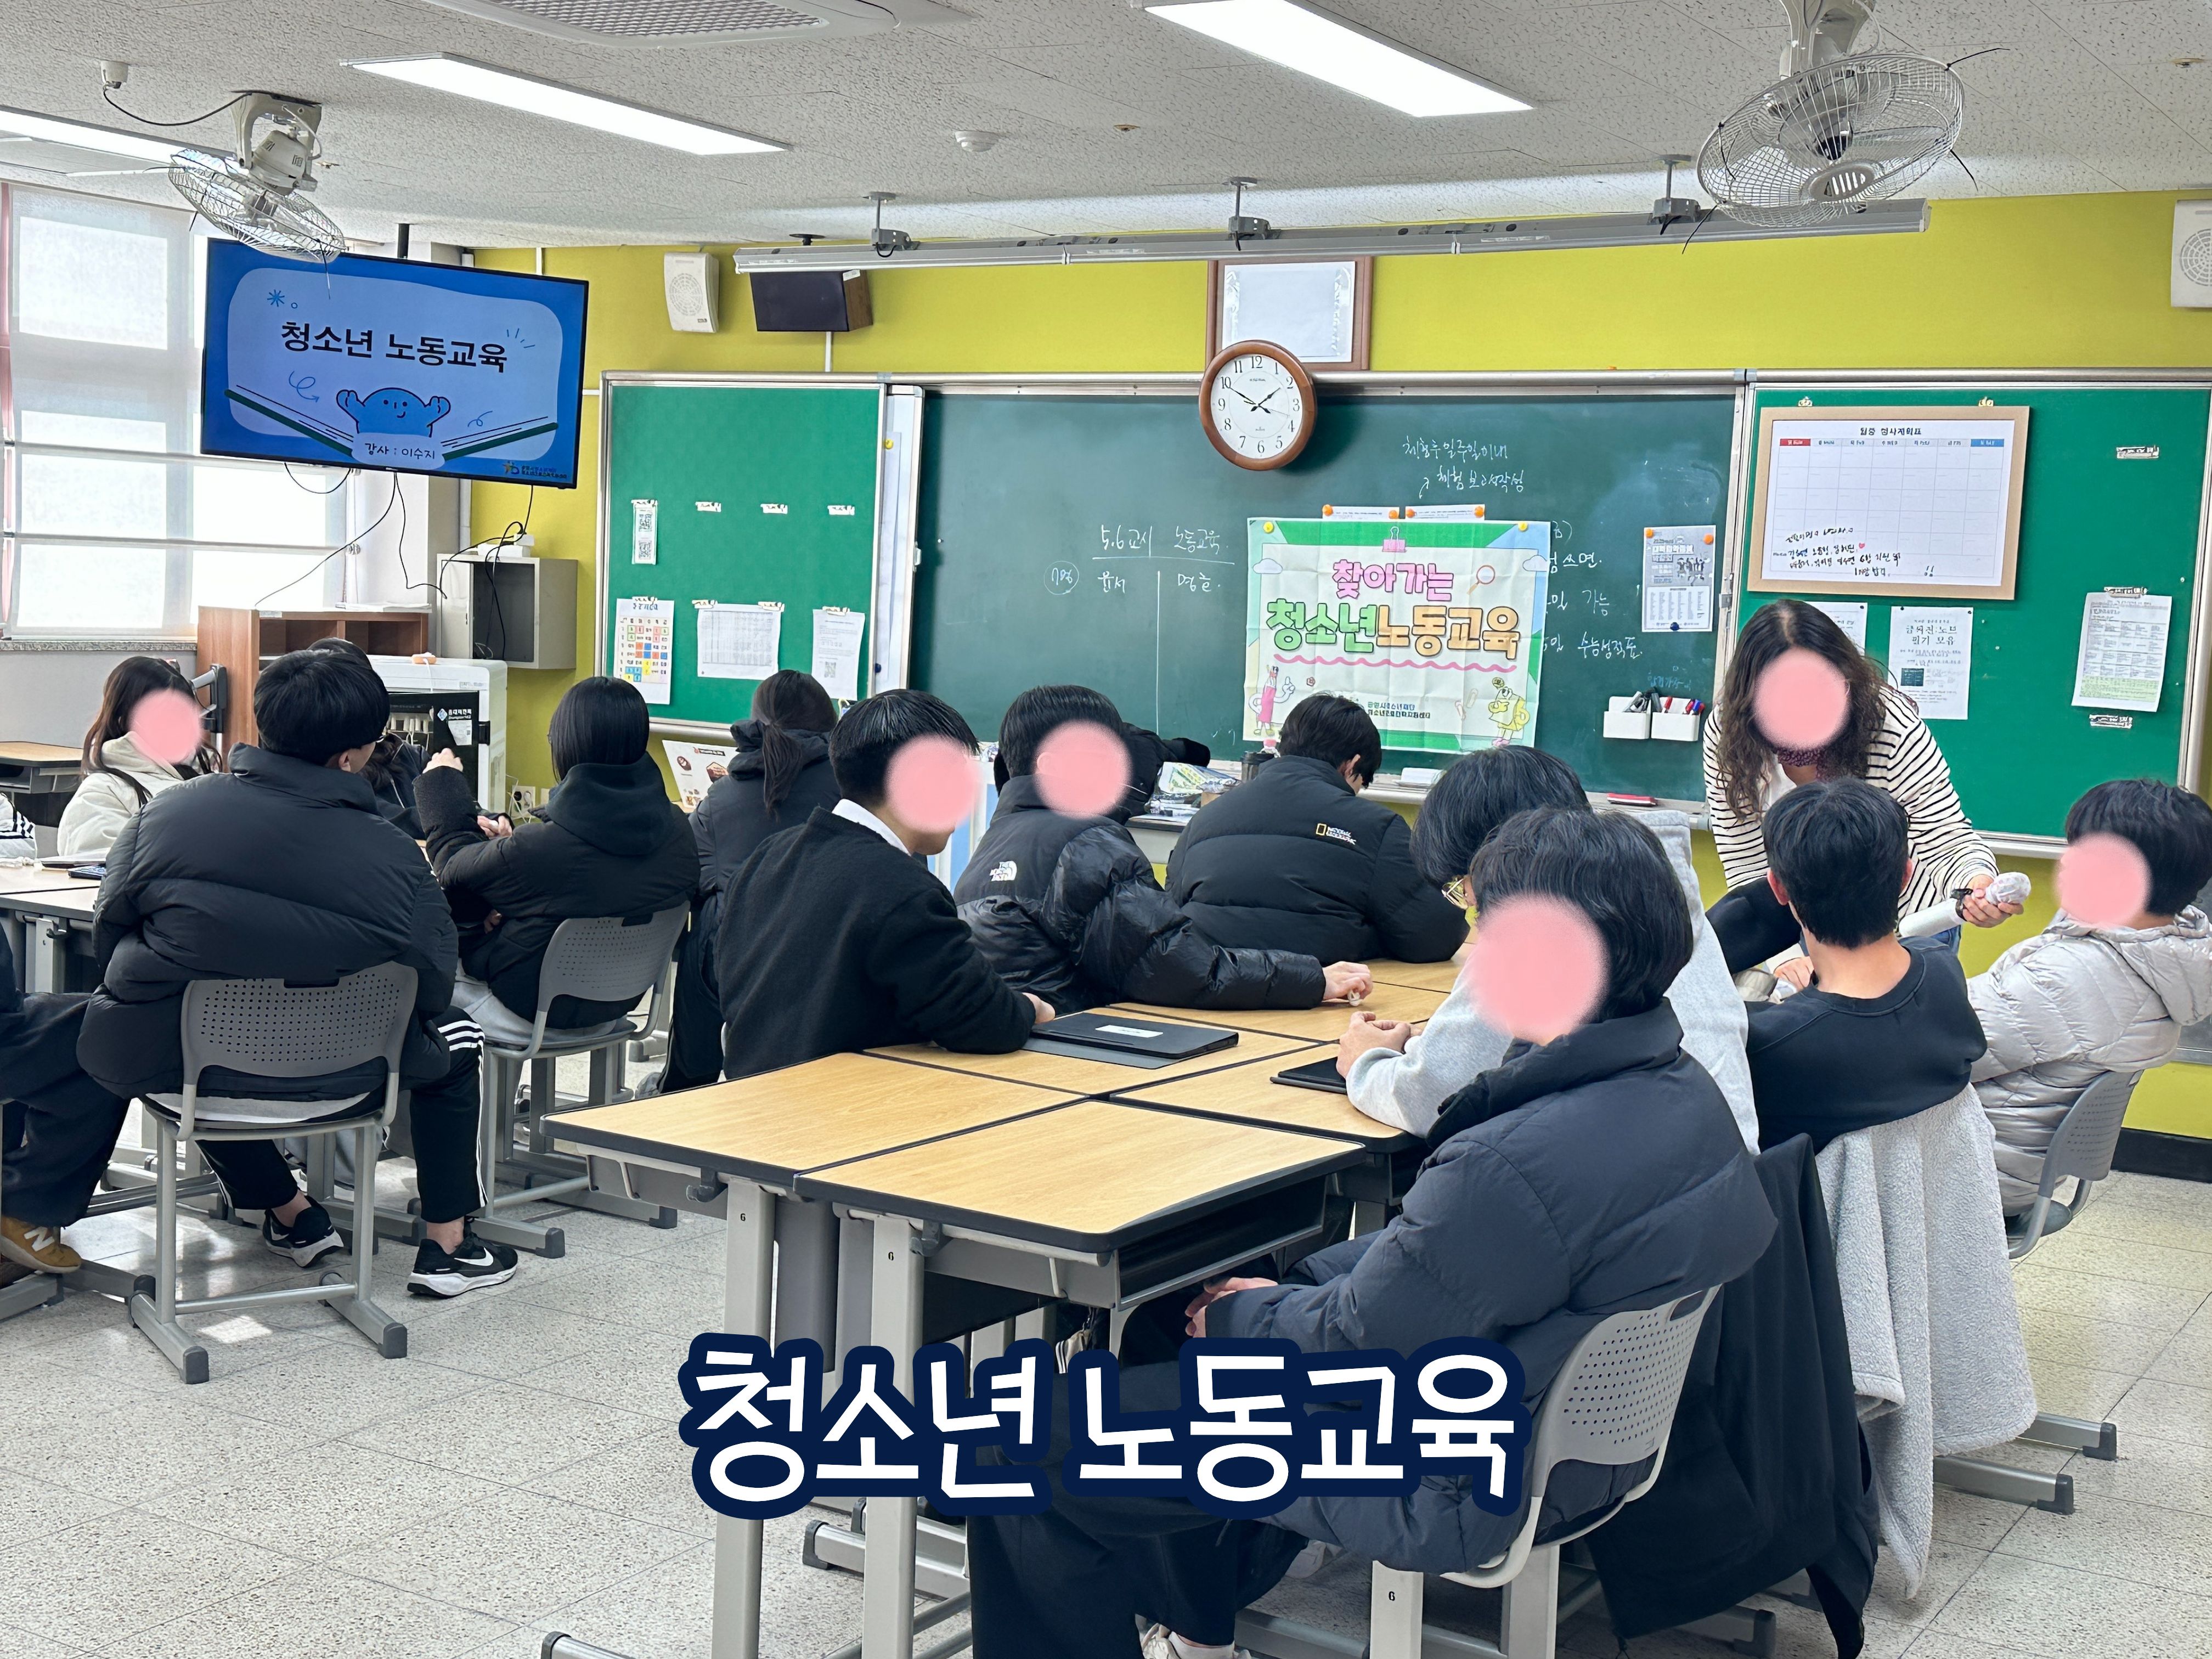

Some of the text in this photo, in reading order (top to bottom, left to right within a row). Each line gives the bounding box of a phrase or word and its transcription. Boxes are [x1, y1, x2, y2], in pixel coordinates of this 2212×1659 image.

[281, 320, 507, 373] 청소년 노동교육
[1234, 360, 1243, 373] 11
[1251, 356, 1263, 369] 12
[1275, 363, 1279, 375] 1
[1221, 376, 1231, 389] 10
[1286, 376, 1293, 389] 2
[1218, 398, 1226, 411] 9
[1293, 398, 1300, 411] 3
[1224, 418, 1232, 431] 8
[1288, 420, 1295, 432] 4
[1239, 436, 1246, 448] 7
[1257, 441, 1265, 453] 6
[1276, 436, 1283, 449] 5
[365, 442, 388, 455] 강사
[402, 447, 436, 460] 이수지
[1331, 558, 1454, 602] 찾아가는
[740, 1212, 746, 1221] 6
[24, 1226, 55, 1252] N
[888, 1251, 894, 1261] 6
